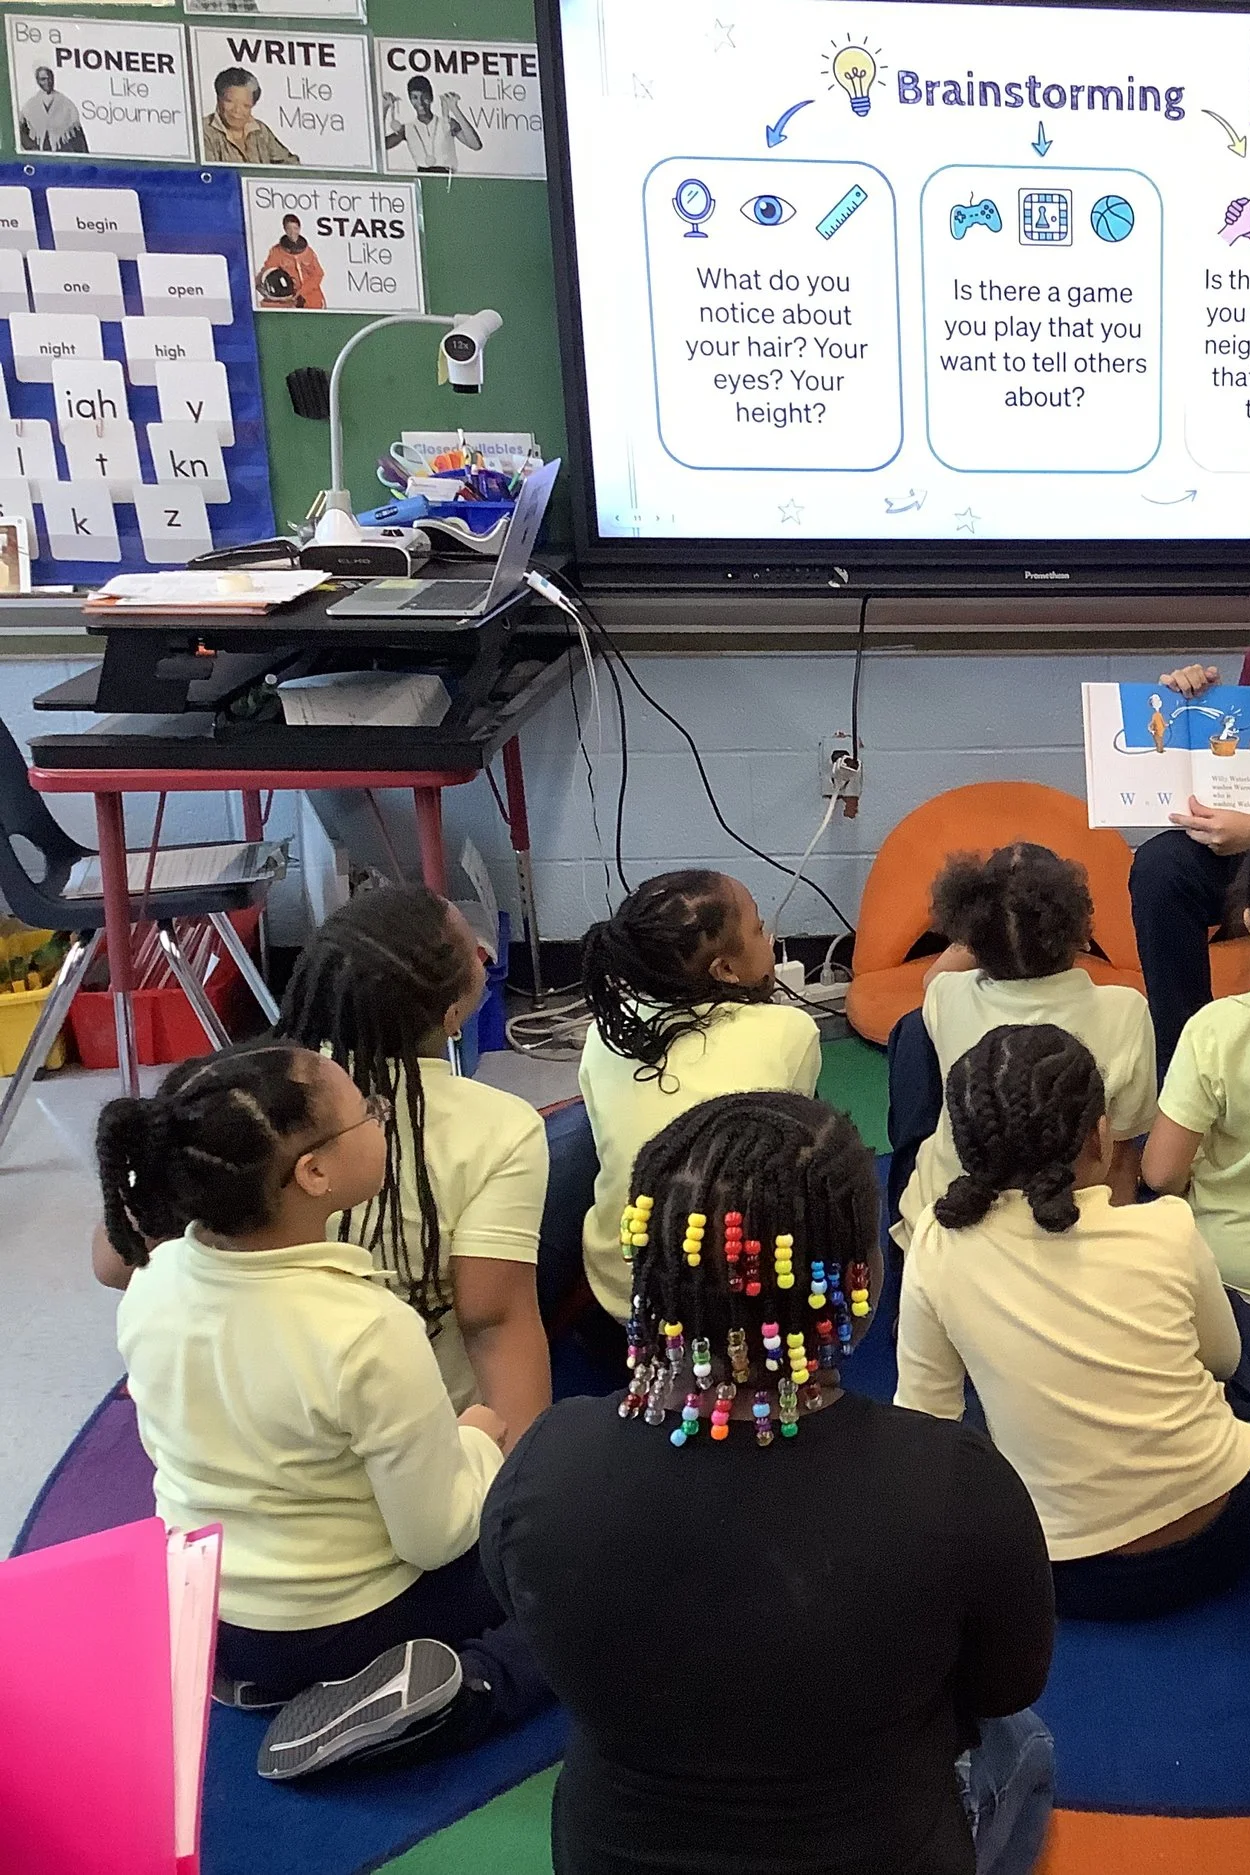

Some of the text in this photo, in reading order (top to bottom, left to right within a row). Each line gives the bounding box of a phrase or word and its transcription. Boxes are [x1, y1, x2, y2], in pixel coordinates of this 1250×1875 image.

[15, 22, 61, 44] Be a
[55, 47, 175, 74] PIONEER
[227, 37, 336, 67] WRITE
[387, 47, 537, 77] COMPETE
[109, 75, 149, 98] Like
[286, 77, 332, 101] Like
[482, 78, 527, 102] Like
[897, 70, 1185, 121] Brainstorming
[81, 100, 181, 126] Sojourner
[280, 106, 345, 133] Maya
[470, 106, 542, 131] Wilma
[255, 187, 405, 213] Shoot for the
[76, 217, 118, 234] begin
[317, 217, 404, 239] STARS
[348, 242, 392, 265] Like
[63, 282, 91, 292] one
[168, 285, 204, 298] open
[349, 272, 397, 294] Mae
[697, 267, 850, 297] What do you
[1205, 269, 1223, 291] Is
[954, 279, 1133, 308] Is there a game
[699, 303, 852, 327] notice about
[1206, 306, 1246, 325] you
[945, 316, 1141, 344] you play that you
[39, 343, 76, 358] night
[155, 345, 186, 360] high
[685, 336, 868, 361] your hair? Your
[940, 350, 1147, 375] want to tell others
[713, 369, 845, 393] eyes? Your
[1005, 385, 1085, 408] about?
[736, 402, 826, 428] height?
[95, 453, 108, 476] t
[170, 450, 209, 477] kn
[71, 507, 91, 535] k
[164, 510, 181, 527] z
[1120, 792, 1136, 805] W
